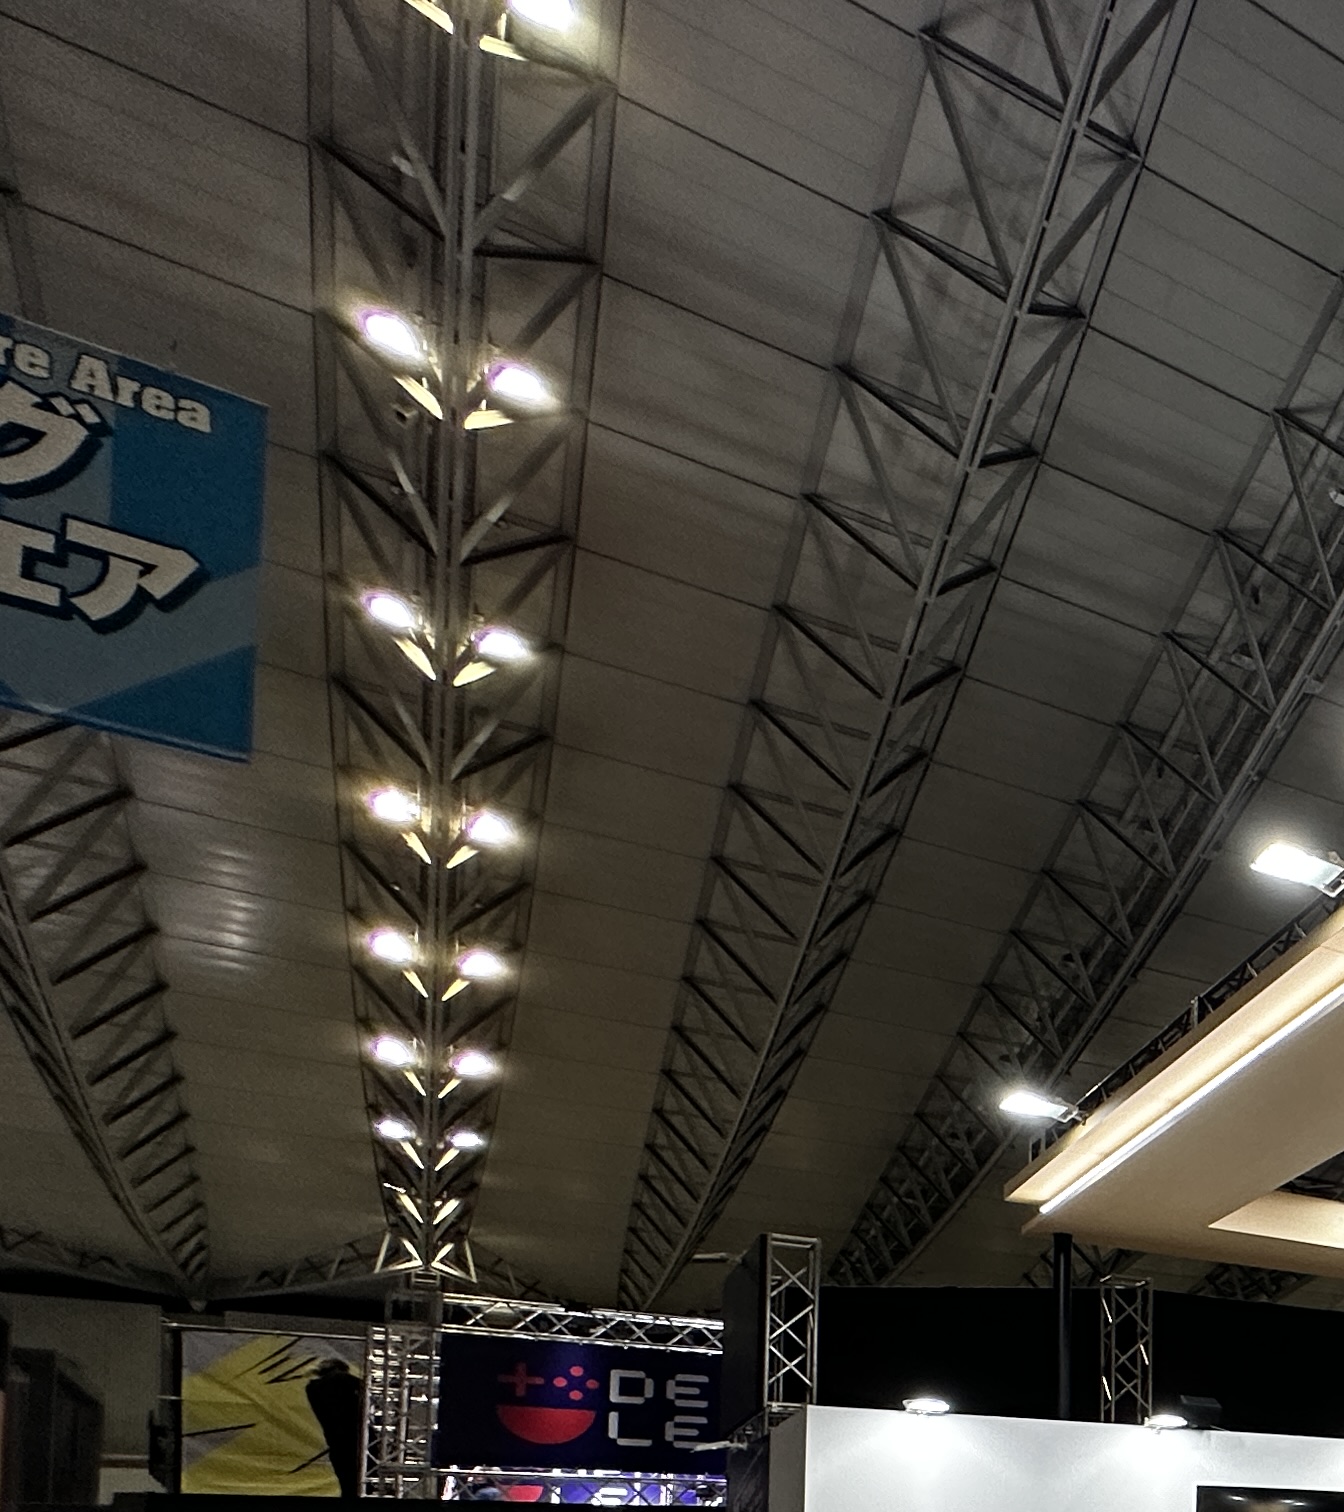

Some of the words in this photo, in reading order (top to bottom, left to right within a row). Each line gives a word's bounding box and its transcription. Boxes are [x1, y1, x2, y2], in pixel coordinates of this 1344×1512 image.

[71, 353, 213, 434] Area
[609, 1369, 709, 1408] DE
[608, 1411, 708, 1448] LE
